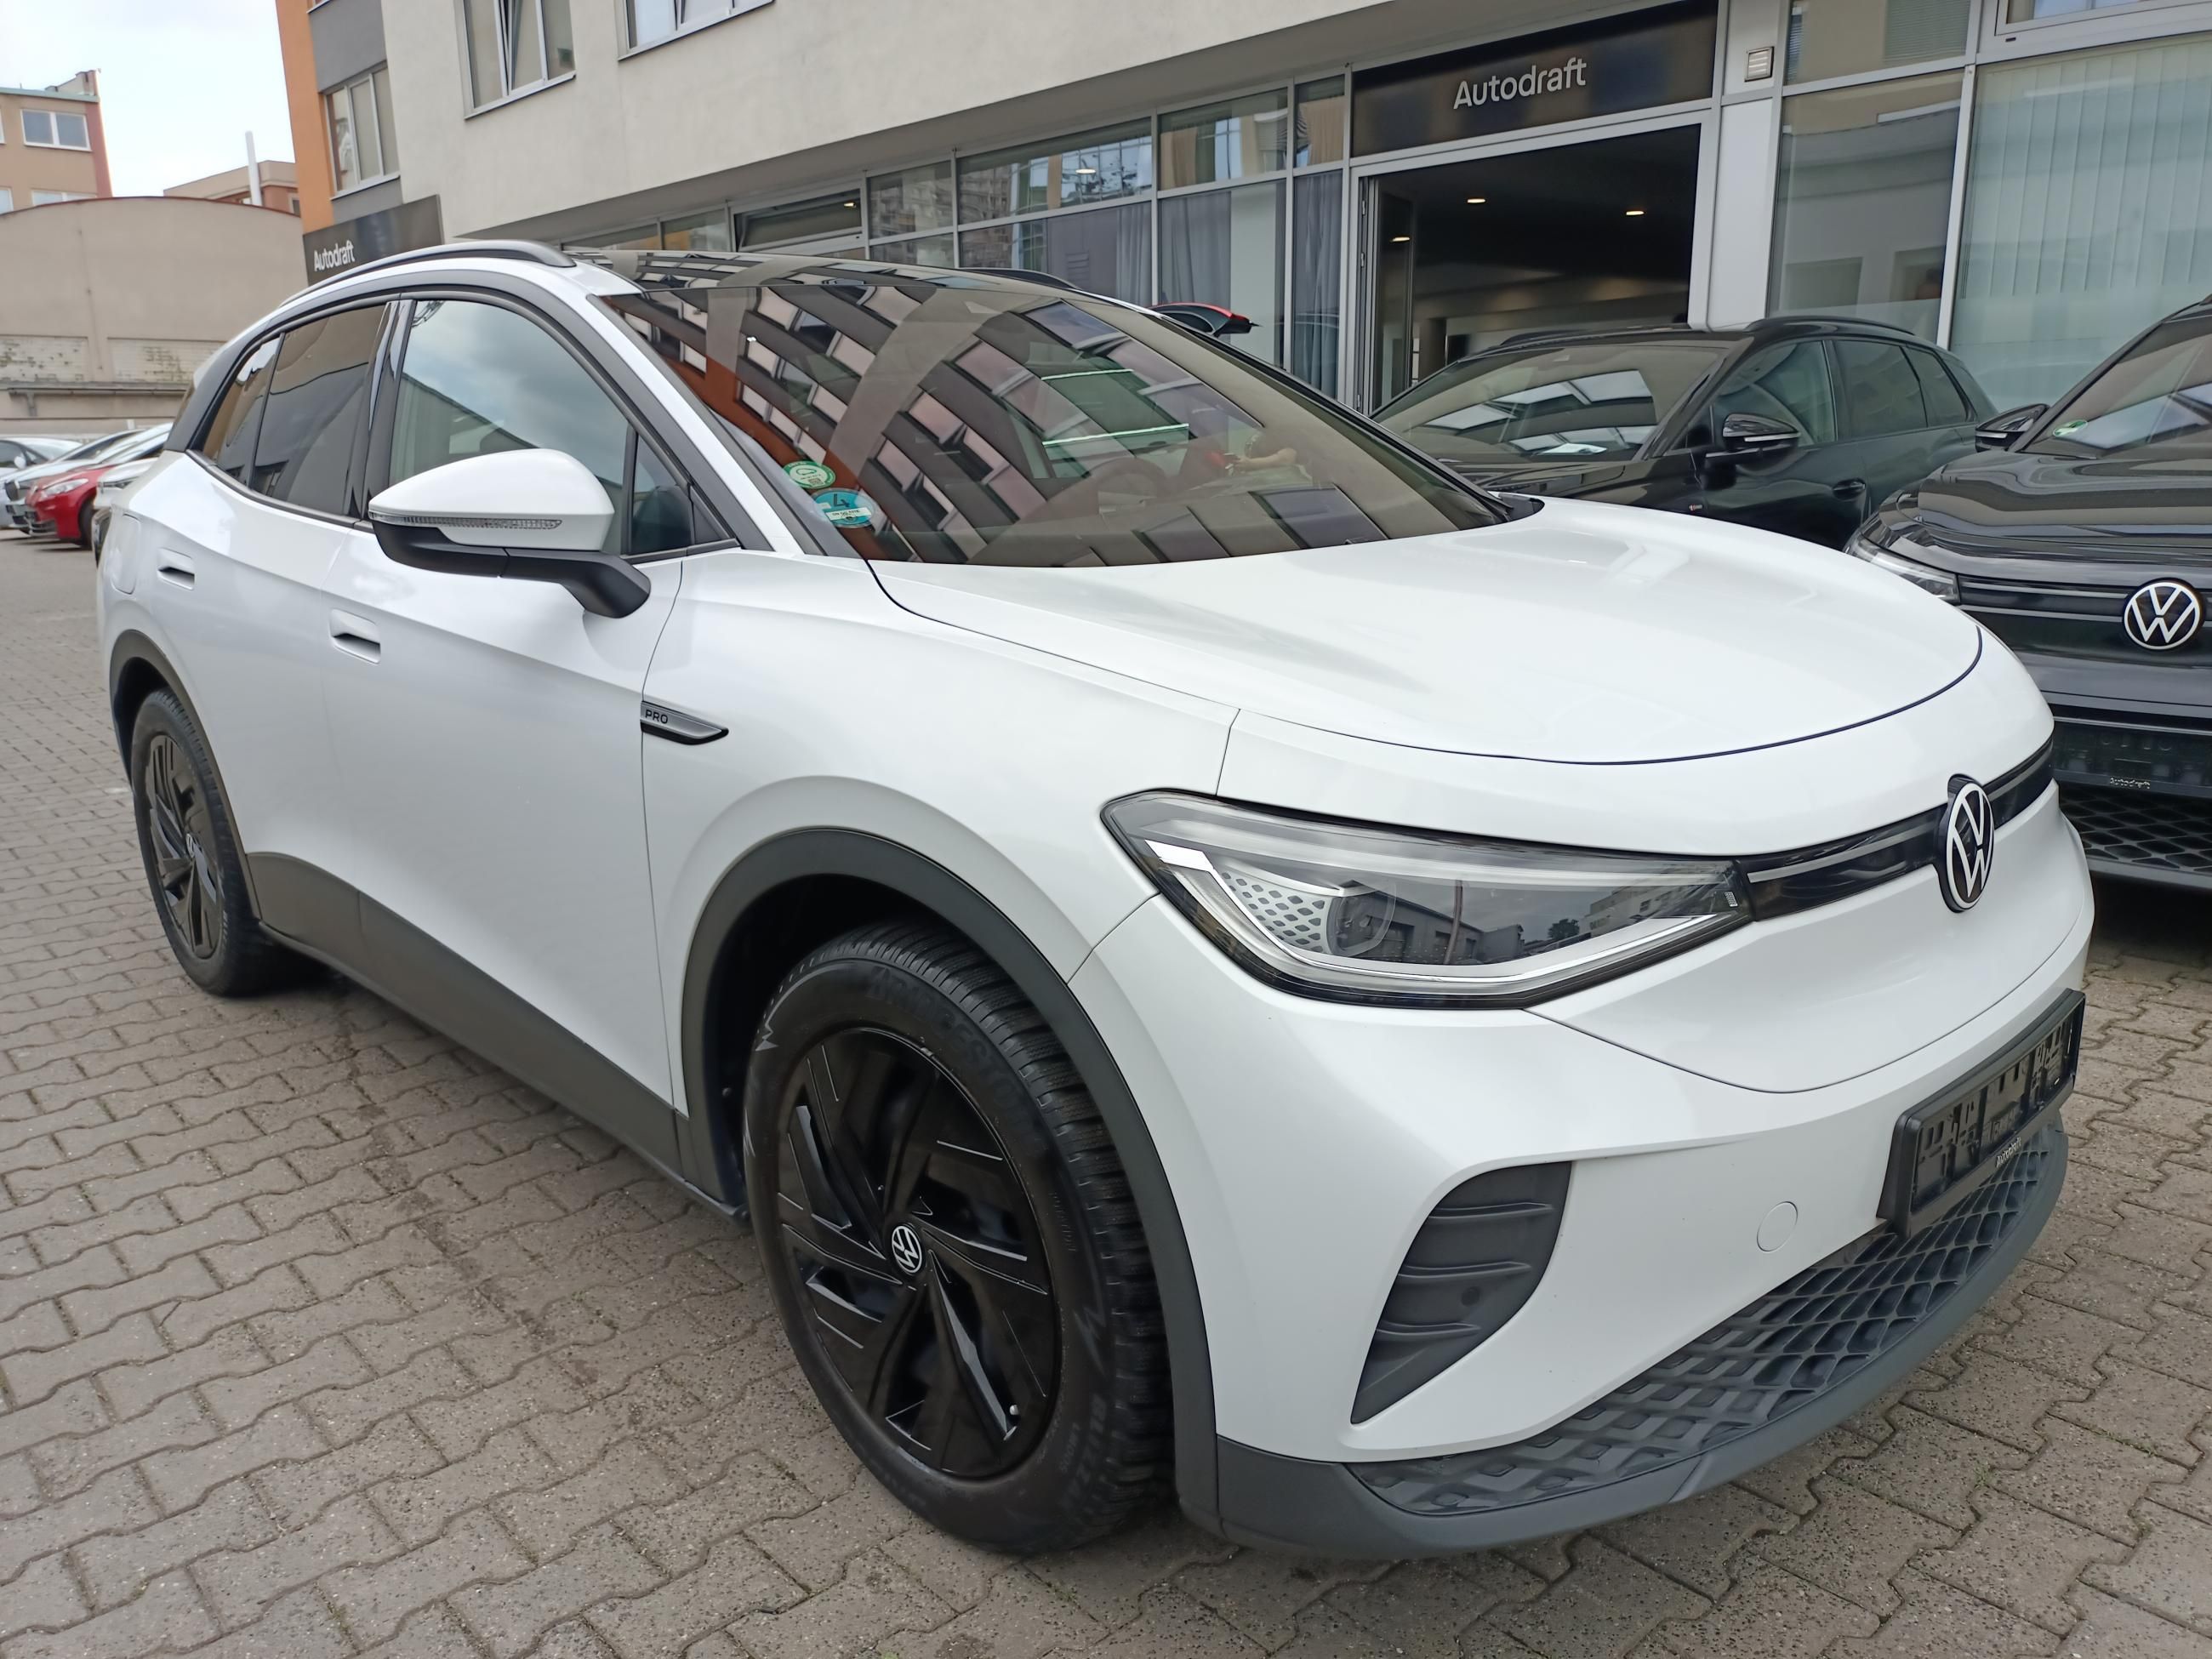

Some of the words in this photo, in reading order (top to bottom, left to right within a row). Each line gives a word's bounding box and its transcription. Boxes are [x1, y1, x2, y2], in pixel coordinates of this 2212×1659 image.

[1453, 57, 1587, 109] Autodraft
[314, 240, 355, 271] Autodraft
[2124, 583, 2200, 649] VW
[645, 709, 669, 724] PRO
[1947, 783, 1994, 909] VW
[892, 1225, 922, 1273] VW
